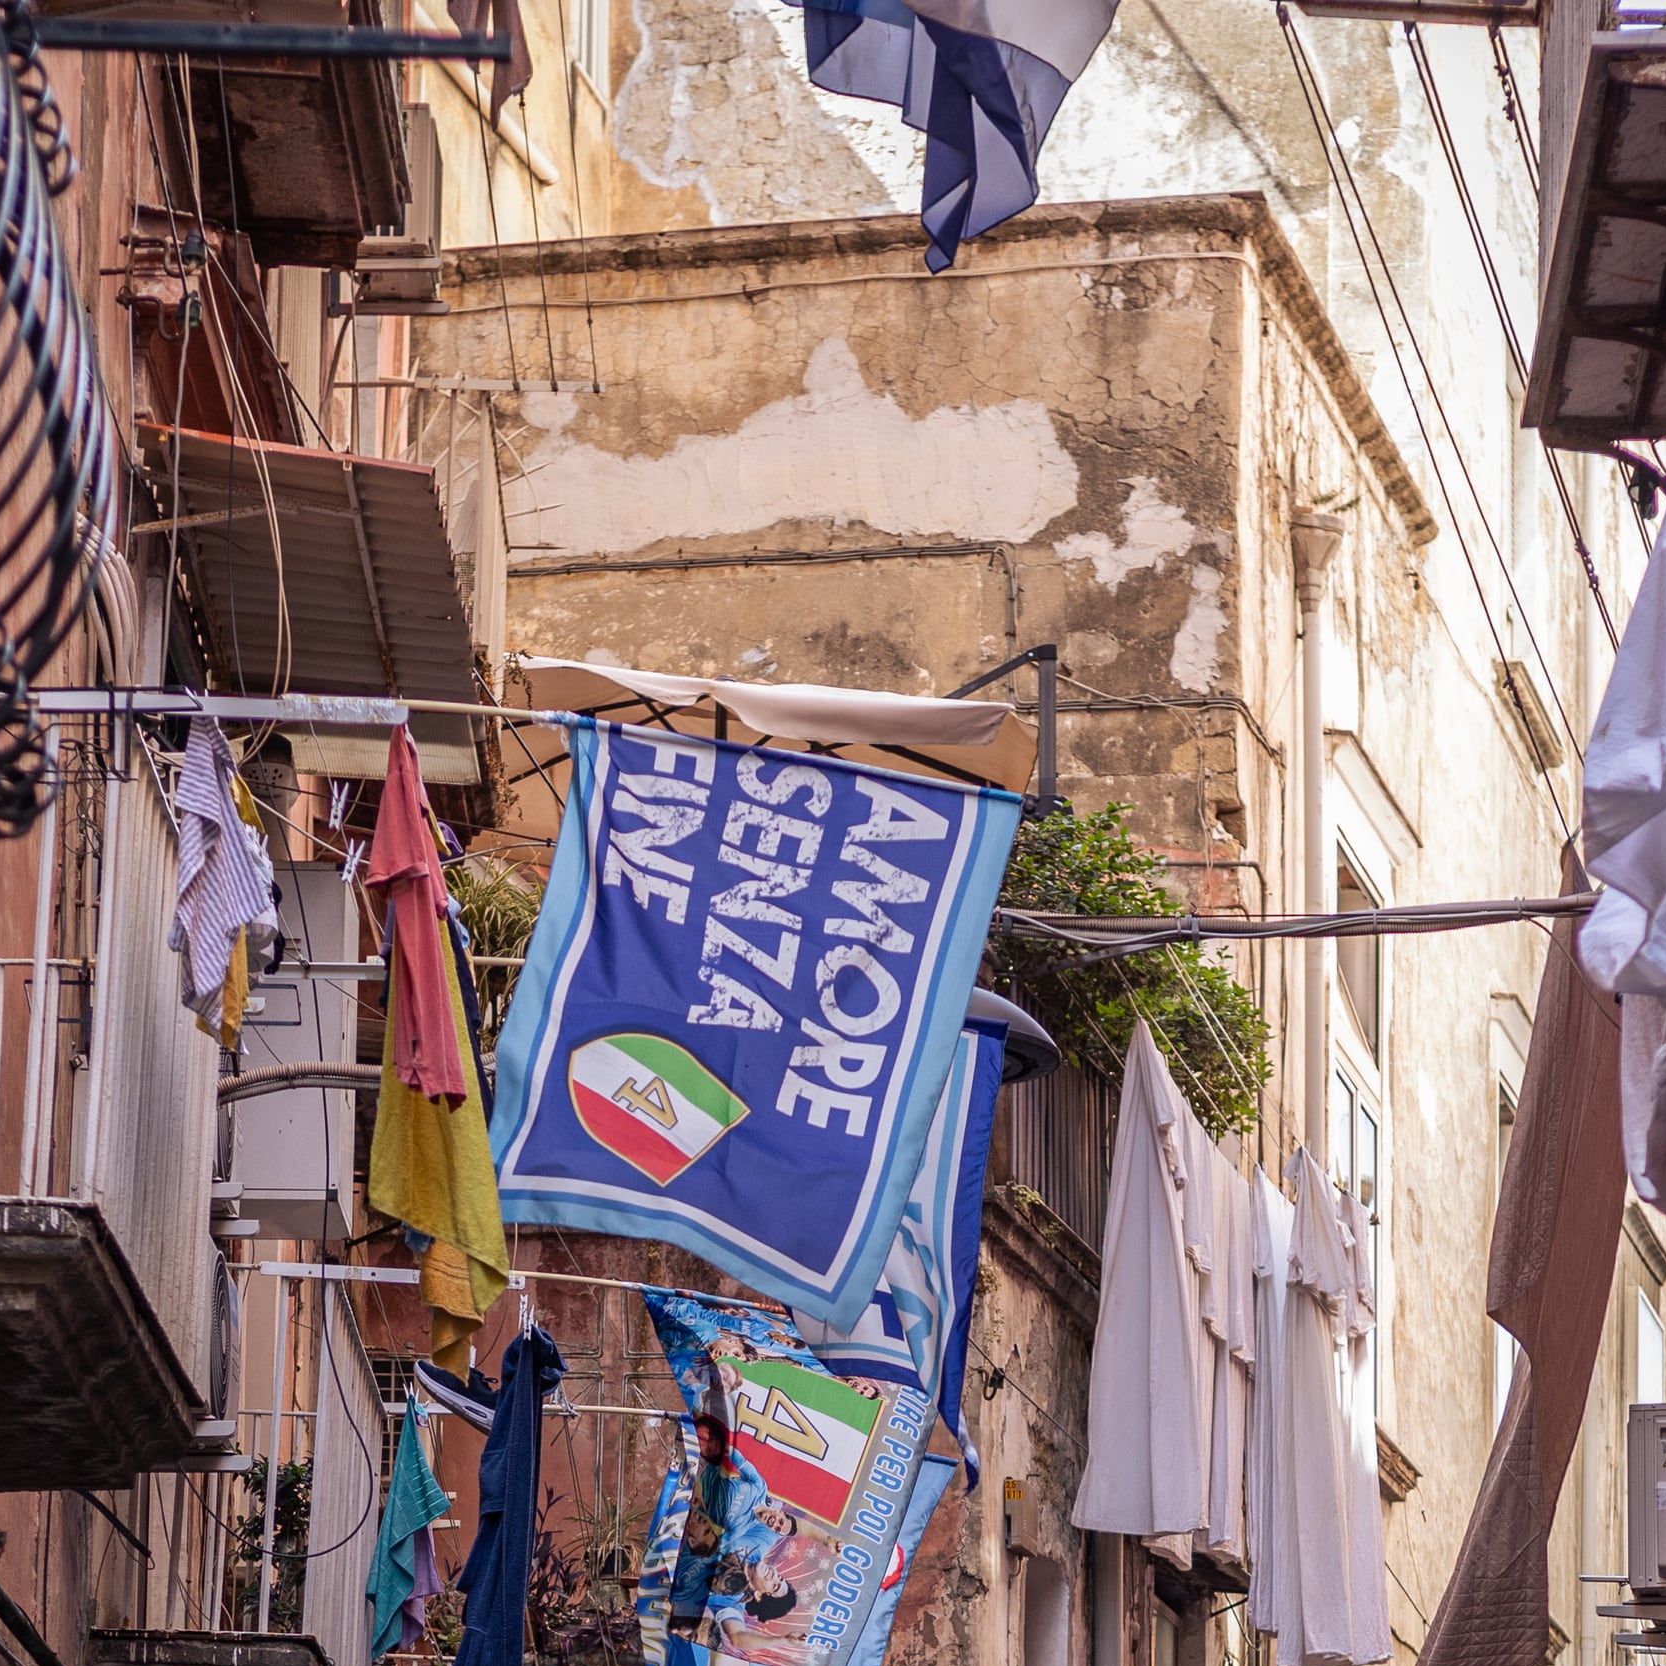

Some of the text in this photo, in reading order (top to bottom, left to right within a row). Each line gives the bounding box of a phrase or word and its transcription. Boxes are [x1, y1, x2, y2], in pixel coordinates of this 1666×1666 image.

[602, 740, 716, 925] FINE
[686, 749, 833, 1033] SENZA
[774, 774, 949, 1137] AMORE
[612, 1076, 678, 1129] 4
[734, 1386, 830, 1461] 4
[873, 1434, 917, 1494] PER
[849, 1487, 896, 1544] POI
[806, 1543, 873, 1651] GODERE
